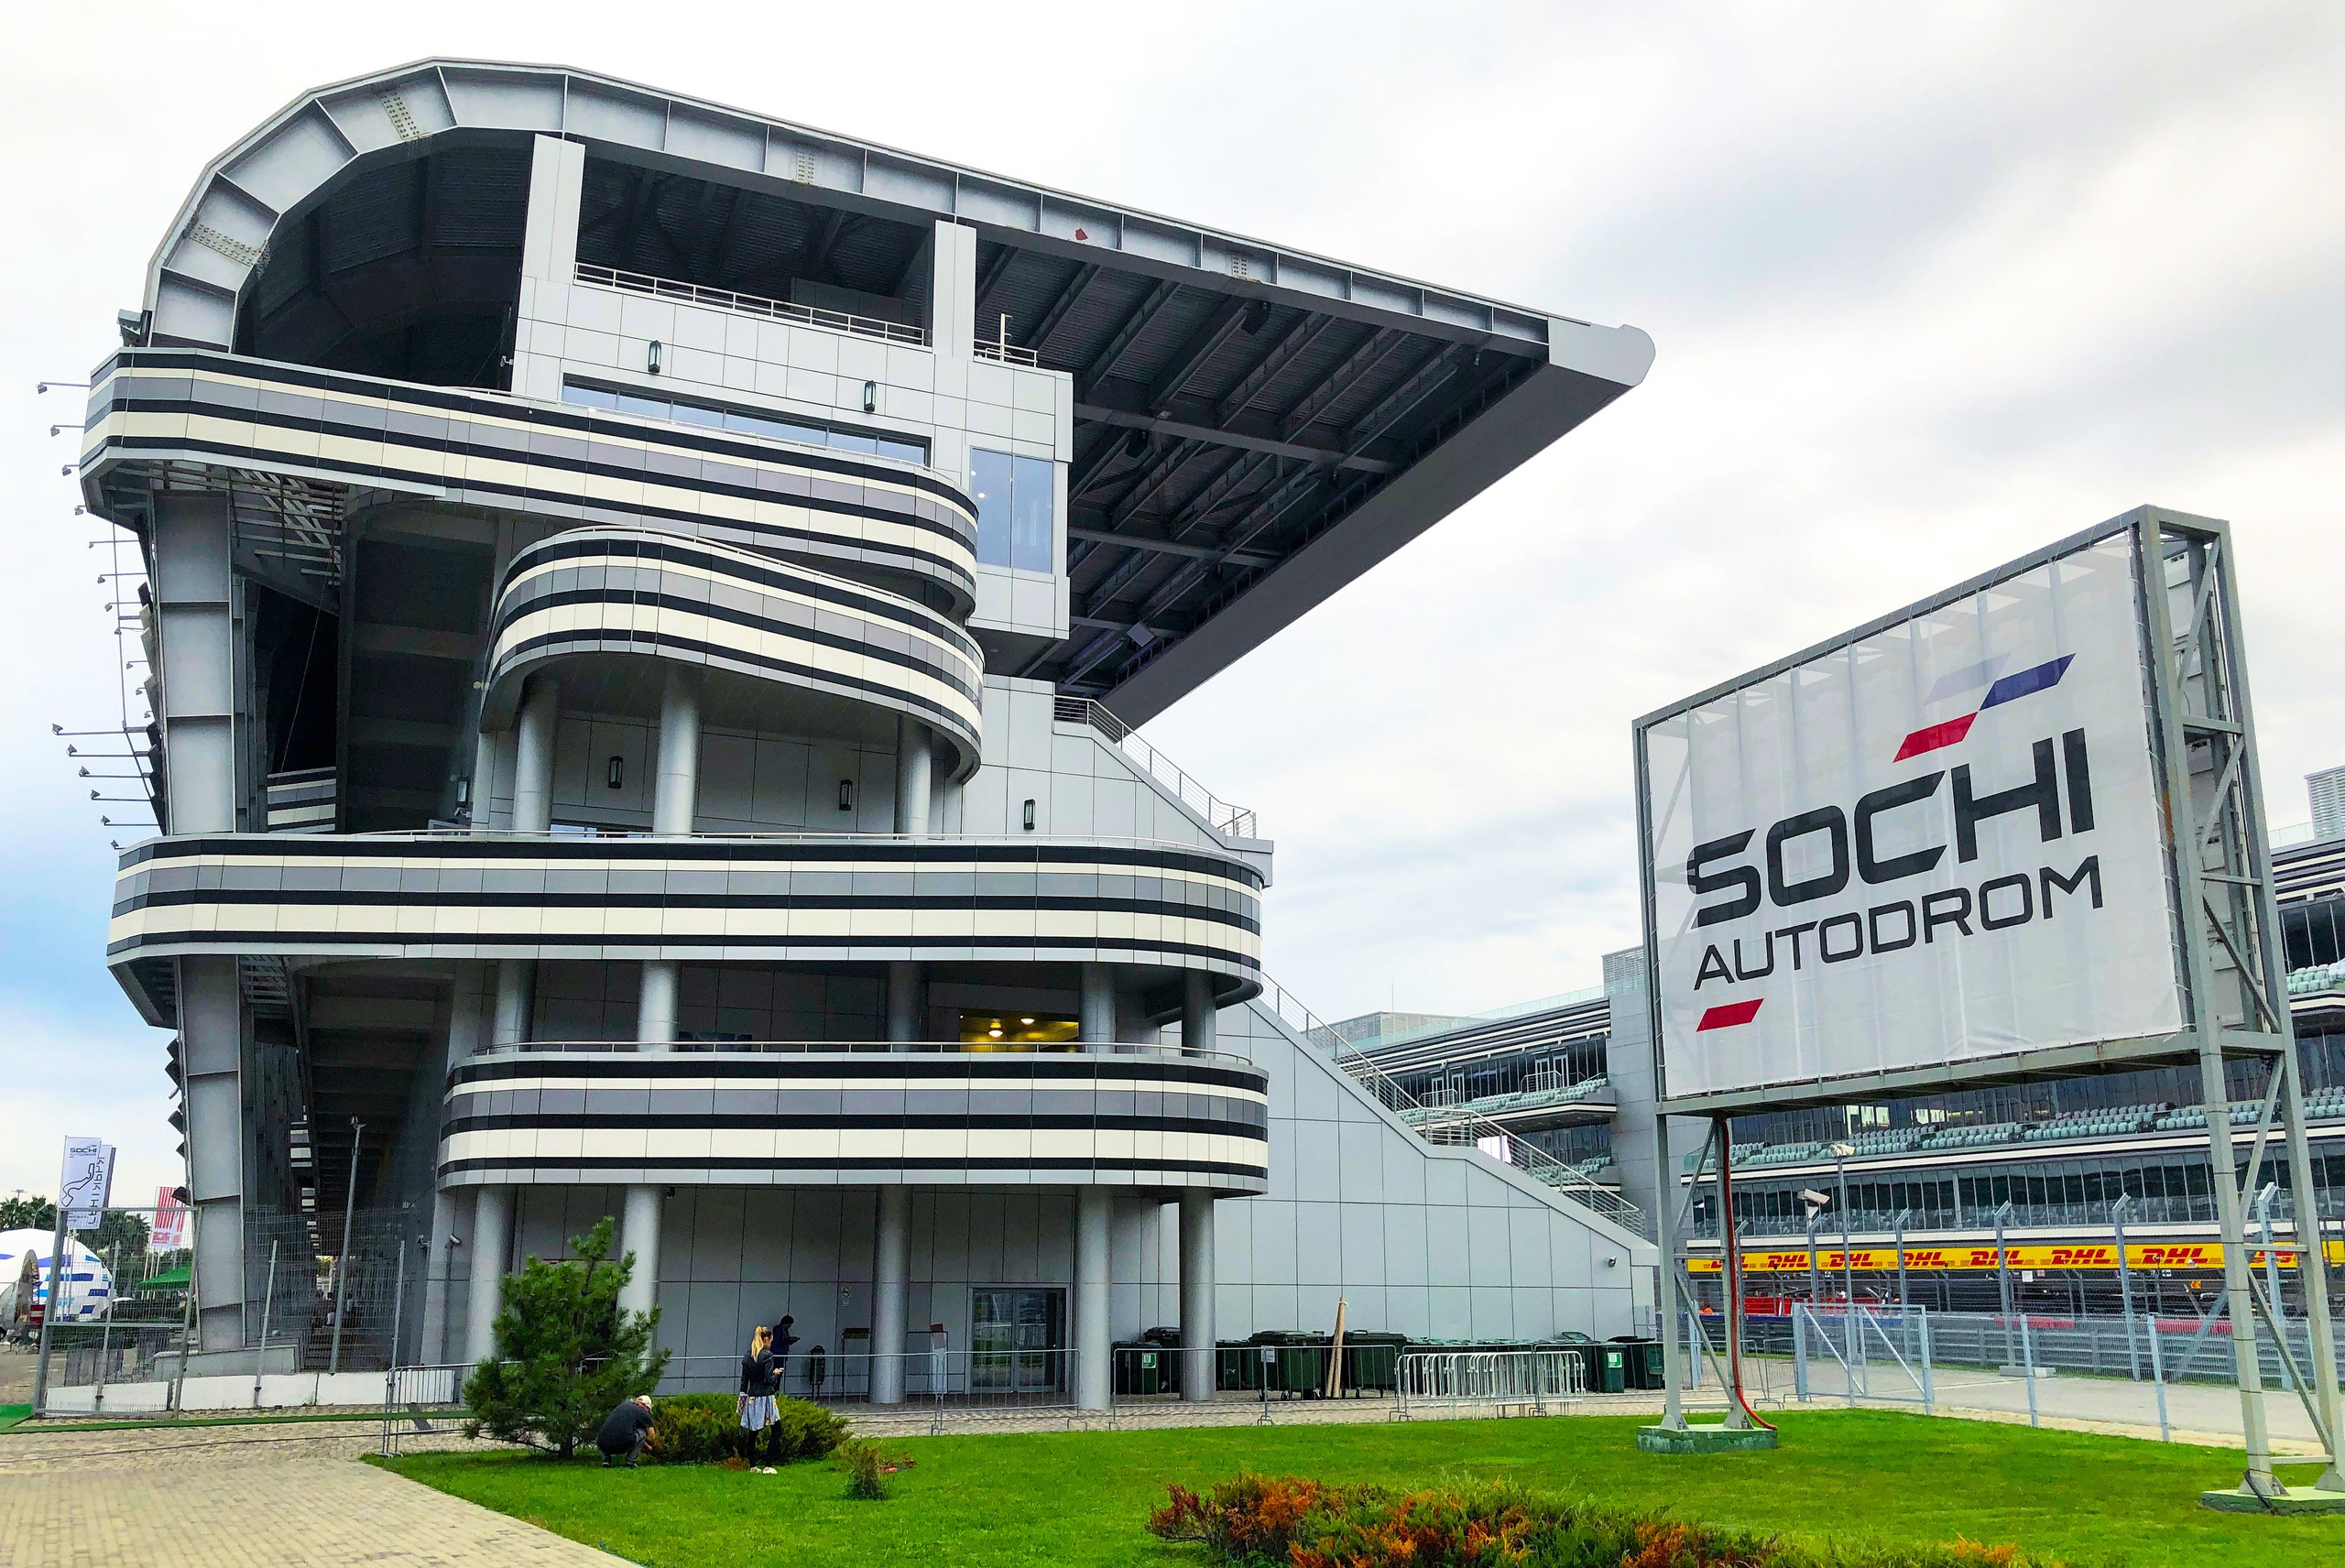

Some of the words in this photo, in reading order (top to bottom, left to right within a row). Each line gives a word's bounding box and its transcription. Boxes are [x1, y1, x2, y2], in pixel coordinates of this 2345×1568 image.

[1687, 727, 2095, 929] SOCHI
[1694, 855, 2104, 991] AUTODROM
[1767, 1255, 1810, 1268] DHL
[1829, 1253, 1874, 1268] DHL
[1903, 1251, 1947, 1266] DHL
[2051, 1248, 2111, 1265] DHL
[2141, 1247, 2209, 1264] DHL
